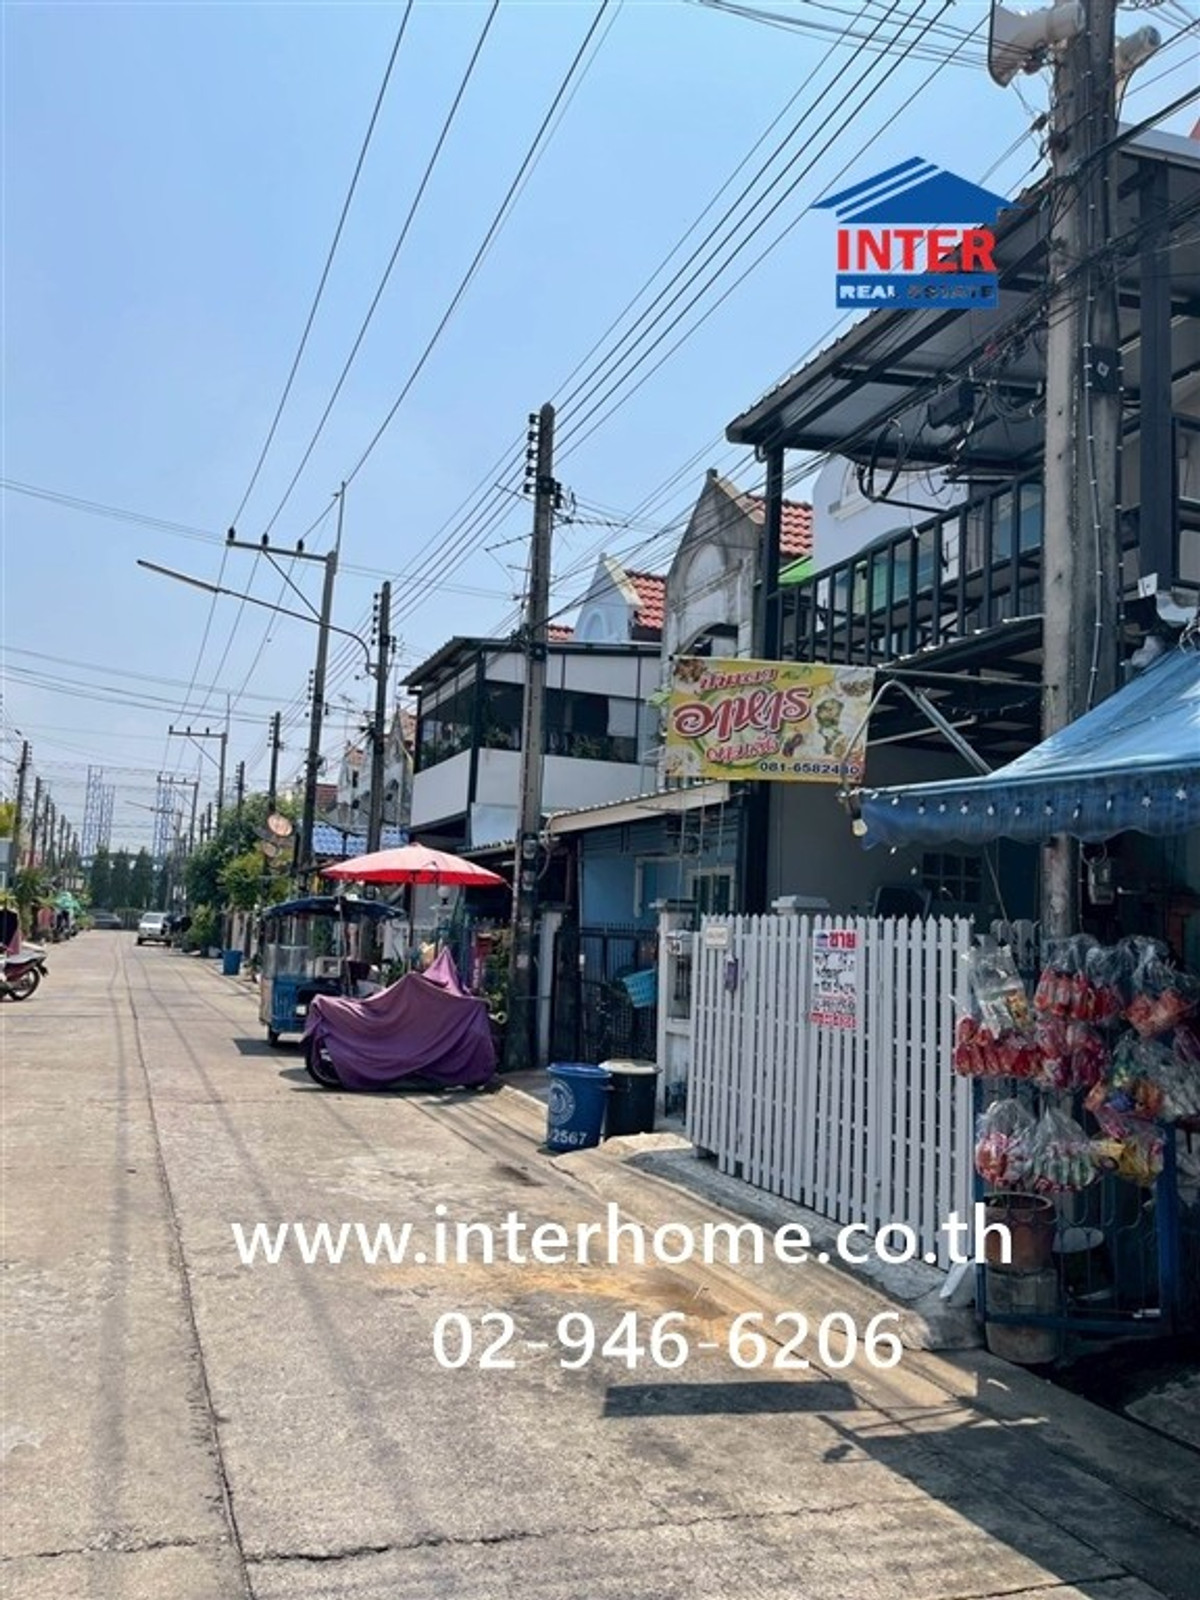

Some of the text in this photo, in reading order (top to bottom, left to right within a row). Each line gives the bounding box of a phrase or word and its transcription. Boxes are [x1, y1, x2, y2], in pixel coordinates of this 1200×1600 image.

[673, 687, 812, 741] อาหาร
[829, 932, 856, 949] ขาย
[552, 1128, 588, 1146] 2567
